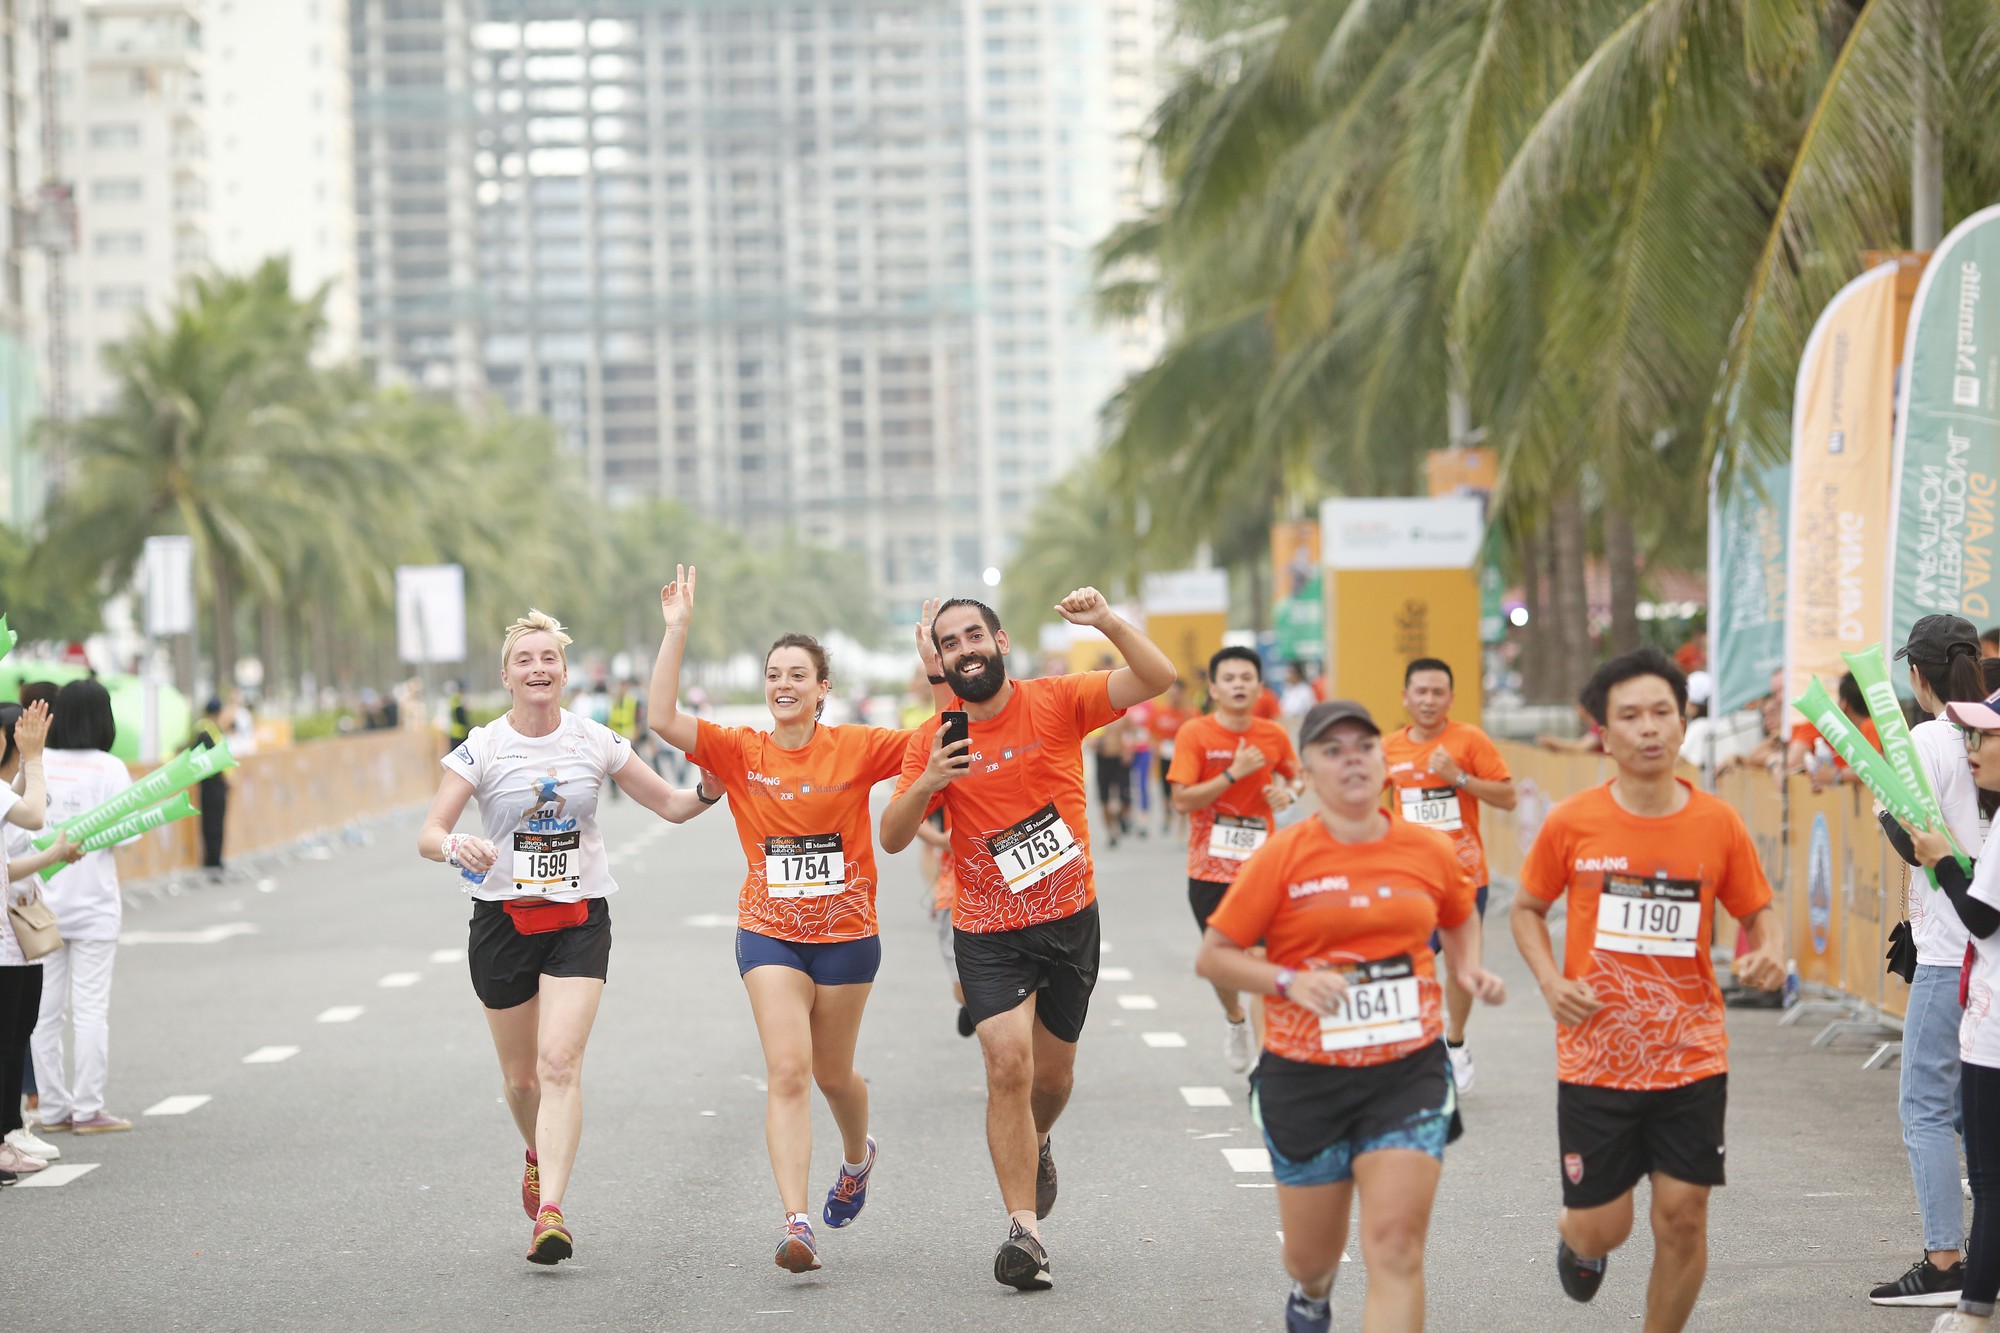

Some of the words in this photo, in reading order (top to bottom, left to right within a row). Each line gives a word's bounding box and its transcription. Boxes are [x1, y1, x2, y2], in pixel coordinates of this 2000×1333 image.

[985, 762, 999, 773] 2018
[780, 792, 794, 800] 2018
[537, 810, 554, 819] TU
[1032, 812, 1054, 829] Manulife
[1415, 802, 1446, 820] 1607
[1011, 829, 1060, 870] 1753
[528, 852, 568, 878] 1599
[782, 856, 830, 880] 1754
[1622, 901, 1681, 933] 1190
[1345, 986, 1402, 1022] 1641
